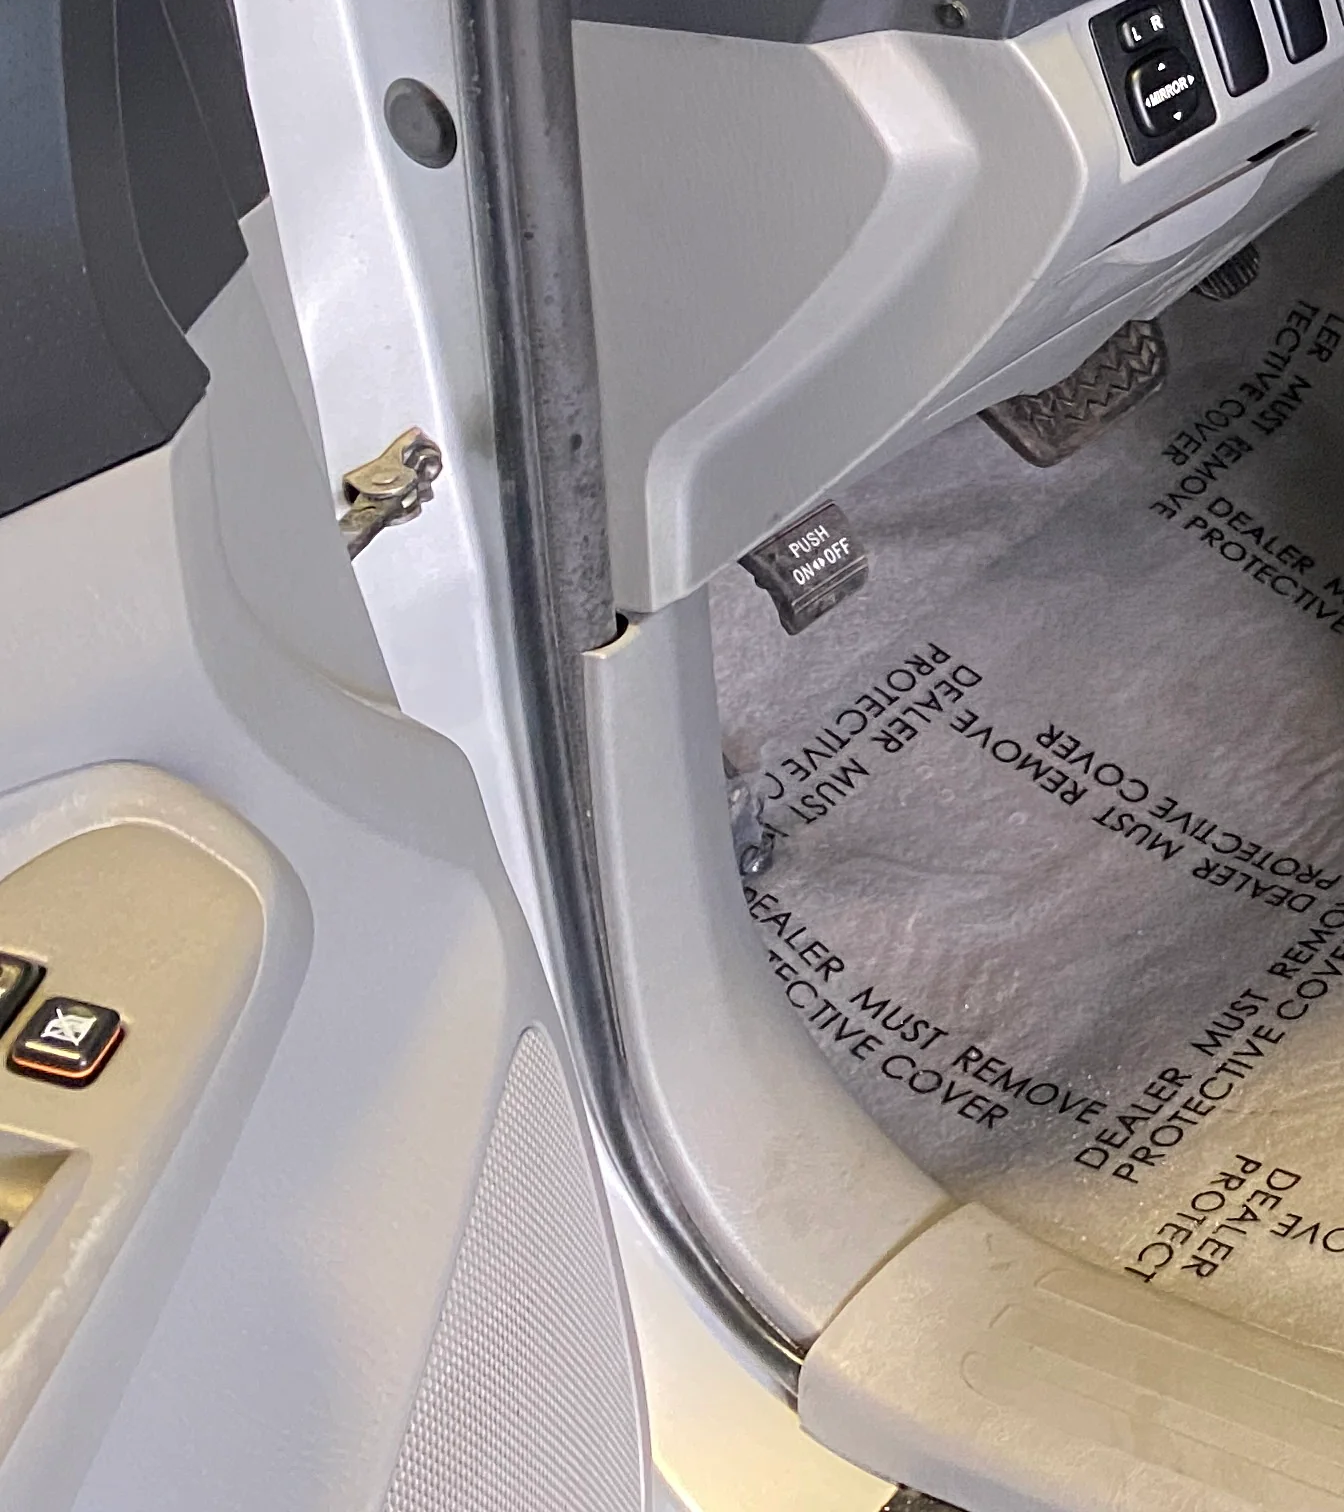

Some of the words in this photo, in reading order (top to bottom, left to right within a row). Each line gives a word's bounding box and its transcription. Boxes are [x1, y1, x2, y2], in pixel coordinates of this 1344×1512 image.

[1131, 26, 1142, 42] L
[1149, 14, 1164, 32] R
[1148, 76, 1189, 108] MIRROR
[1161, 399, 1246, 466] COVER
[1252, 375, 1312, 436] MUST
[1149, 436, 1253, 520] REMOVE
[788, 524, 831, 559] PUSH
[1207, 496, 1316, 575] DEALER
[780, 642, 951, 783] PROTECTIVE
[870, 664, 983, 754] DEALER
[788, 757, 871, 825] MUST
[949, 708, 1088, 807] REMOVE
[1035, 719, 1150, 804] COVER
[1092, 805, 1185, 861] MUST
[1149, 795, 1343, 891] PROTECTIVE
[1192, 856, 1317, 914] DEALER
[849, 986, 949, 1050] MUST
[951, 1045, 1109, 1125] REMOVE
[881, 1054, 1009, 1129] COVER
[1074, 1066, 1193, 1170] DEALER
[1190, 988, 1270, 1057] MUST
[1111, 1024, 1286, 1184] PROTECTIVE
[1180, 1166, 1303, 1279] DEALER
